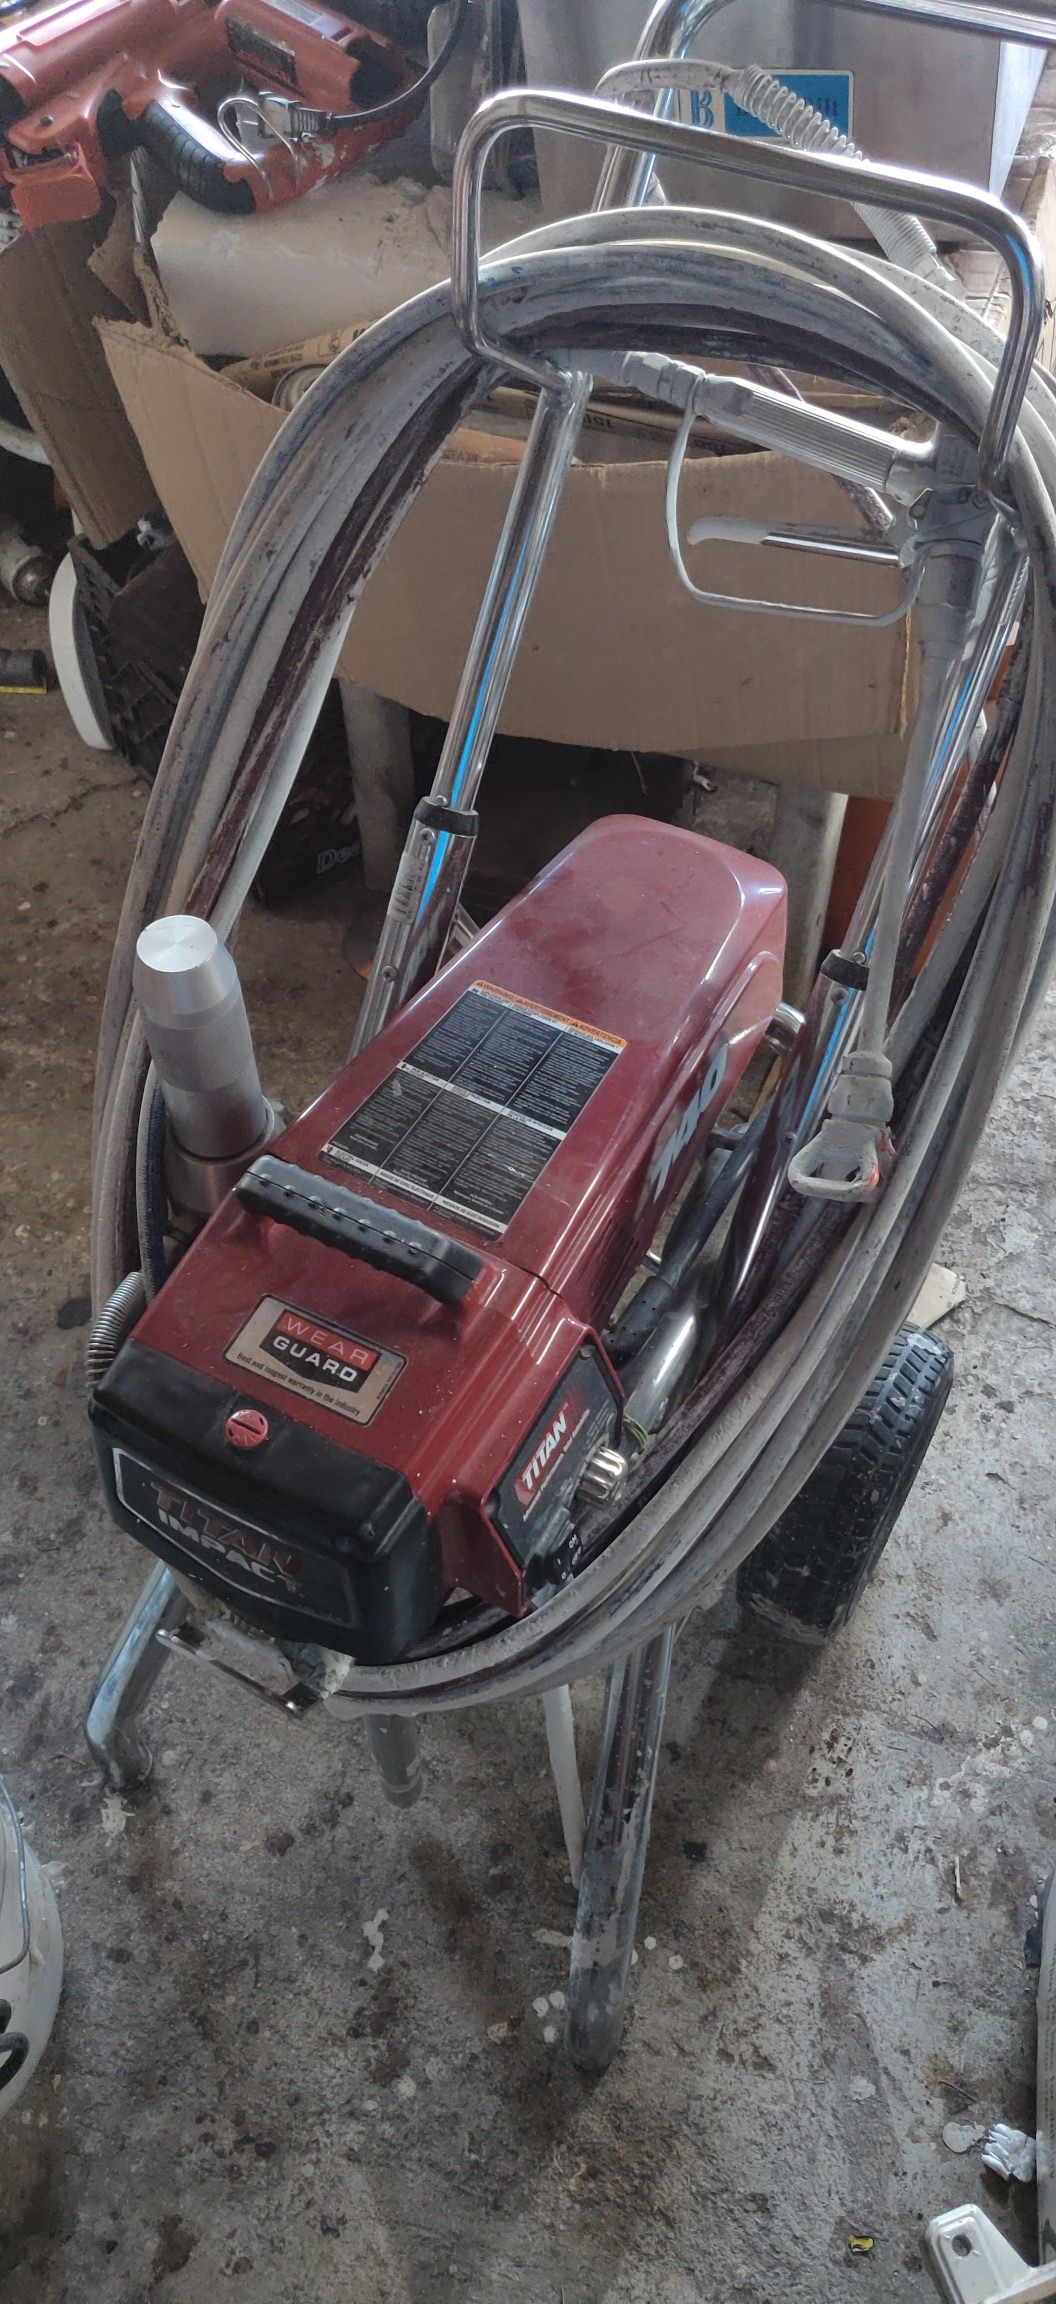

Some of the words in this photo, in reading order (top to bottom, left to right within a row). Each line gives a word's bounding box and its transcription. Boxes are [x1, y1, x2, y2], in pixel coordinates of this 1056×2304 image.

[650, 1042, 728, 1203] 740
[272, 1335, 358, 1382] GUARD
[287, 1317, 369, 1364] WEAR
[237, 1352, 251, 1365] Best
[288, 1376, 316, 1395] warranty
[324, 1392, 334, 1403] the
[522, 1410, 567, 1490] TITAN
[151, 1481, 301, 1579] TITAN
